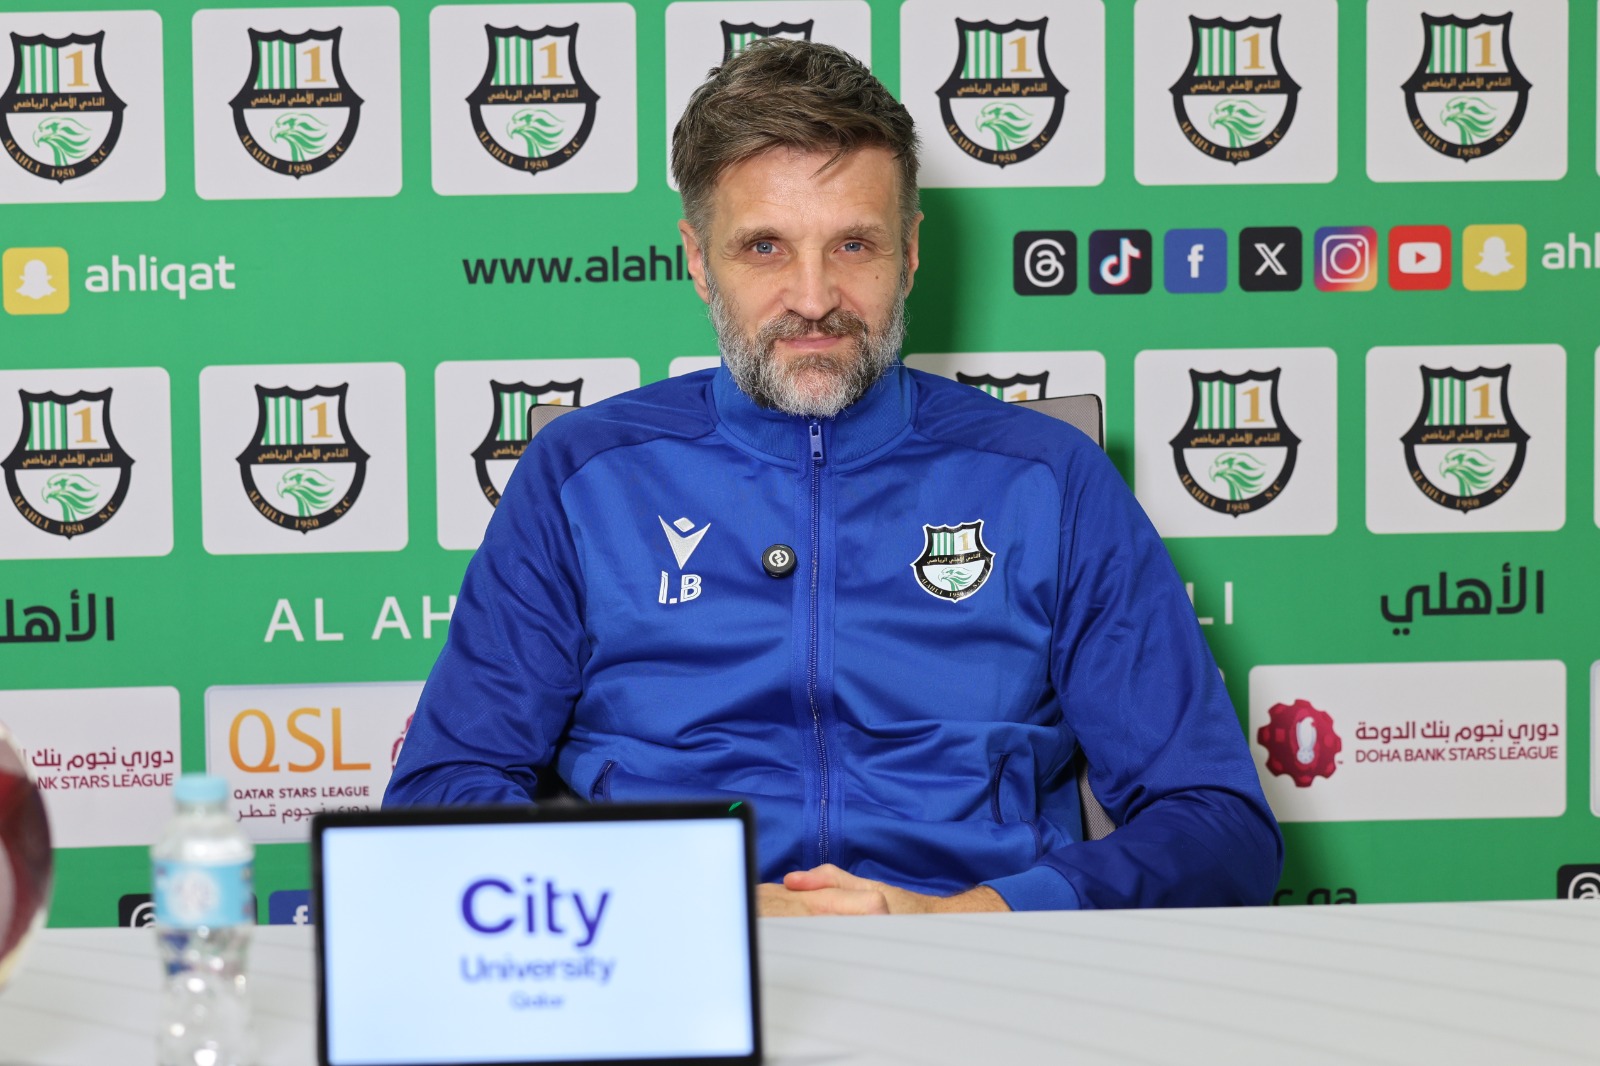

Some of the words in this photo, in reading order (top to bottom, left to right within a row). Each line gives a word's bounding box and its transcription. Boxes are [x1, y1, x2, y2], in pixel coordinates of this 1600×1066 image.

[540, 42, 562, 79] 1
[1009, 35, 1032, 73] 1
[1243, 33, 1264, 70] 1
[1474, 31, 1497, 68] 1
[66, 49, 89, 88] 1
[304, 45, 327, 83] 1
[1023, 83, 1048, 96] النادي
[1255, 80, 1280, 92] النادي
[1486, 77, 1512, 90] النادي
[80, 97, 105, 110] النادي
[317, 92, 342, 106] النادي
[553, 89, 579, 102] النادي
[993, 153, 1017, 162] 1950
[1226, 150, 1251, 160] 1950
[1457, 148, 1481, 157] 1950
[51, 168, 75, 177] 1950
[288, 164, 313, 173] 1950
[525, 160, 548, 169] 1950
[1541, 231, 1600, 269] ahl
[462, 246, 692, 284] www.alahl
[84, 254, 236, 300] ahliqat
[1242, 386, 1264, 424] 1
[1473, 383, 1496, 420] 1
[75, 406, 97, 444] 1
[310, 402, 332, 439] 1
[1255, 433, 1280, 445] النادي
[1485, 429, 1510, 442] النادي
[88, 454, 112, 466] النادي
[324, 449, 349, 460] النادي
[1226, 503, 1250, 512] 1950
[1456, 499, 1480, 508] 1950
[60, 524, 84, 534] 1950
[295, 519, 319, 529] 1950
[959, 532, 971, 551] 1
[658, 570, 702, 605] I.B
[1380, 562, 1544, 636] الأهلي
[0, 589, 115, 644] الأهل
[264, 598, 344, 643] AL
[371, 595, 457, 640] AH
[228, 707, 371, 773] QSL
[1355, 721, 1416, 744] الدوحة
[1421, 720, 1450, 743] بنك
[1455, 719, 1503, 742] نجوم
[1508, 722, 1559, 745] دوري
[32, 748, 61, 771] بنك
[67, 747, 116, 771] نجوم
[121, 749, 174, 772] دوري
[1355, 749, 1402, 763] DOHA
[1404, 748, 1446, 762] BANK
[1449, 747, 1497, 761] STARS
[1499, 746, 1559, 760] LEAGUE
[37, 776, 58, 789] NK
[61, 775, 110, 789] STARS
[113, 773, 174, 788] LEAGUE
[233, 788, 274, 800] QATAR
[279, 787, 317, 799] STARS
[322, 786, 369, 798] LEAGUE
[461, 872, 609, 948] City
[459, 952, 616, 986] University
